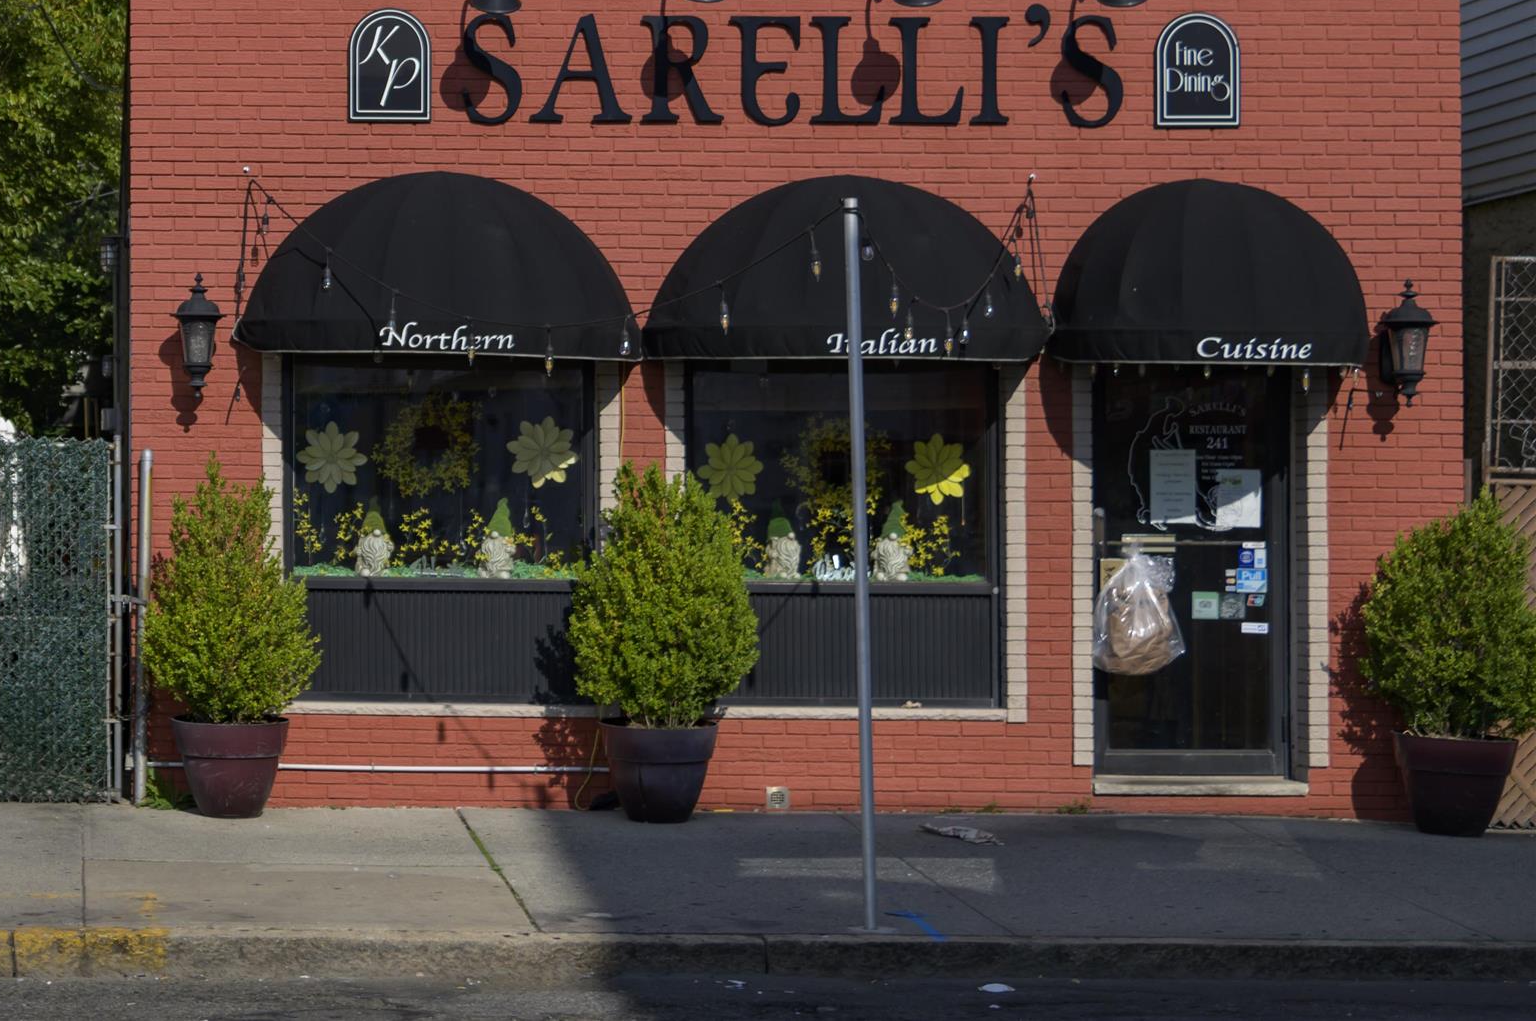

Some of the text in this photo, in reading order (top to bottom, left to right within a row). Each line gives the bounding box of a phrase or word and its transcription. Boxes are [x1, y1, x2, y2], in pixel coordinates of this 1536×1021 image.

[462, 3, 1125, 128] SARELLI'S
[1175, 40, 1214, 67] Fine
[1166, 67, 1231, 102] Dining
[379, 321, 517, 351] Northern
[1196, 336, 1313, 360] Cuisine
[1189, 425, 1248, 435] RESTAURANT
[1206, 437, 1229, 449] 241
[1241, 571, 1262, 581] Pull
